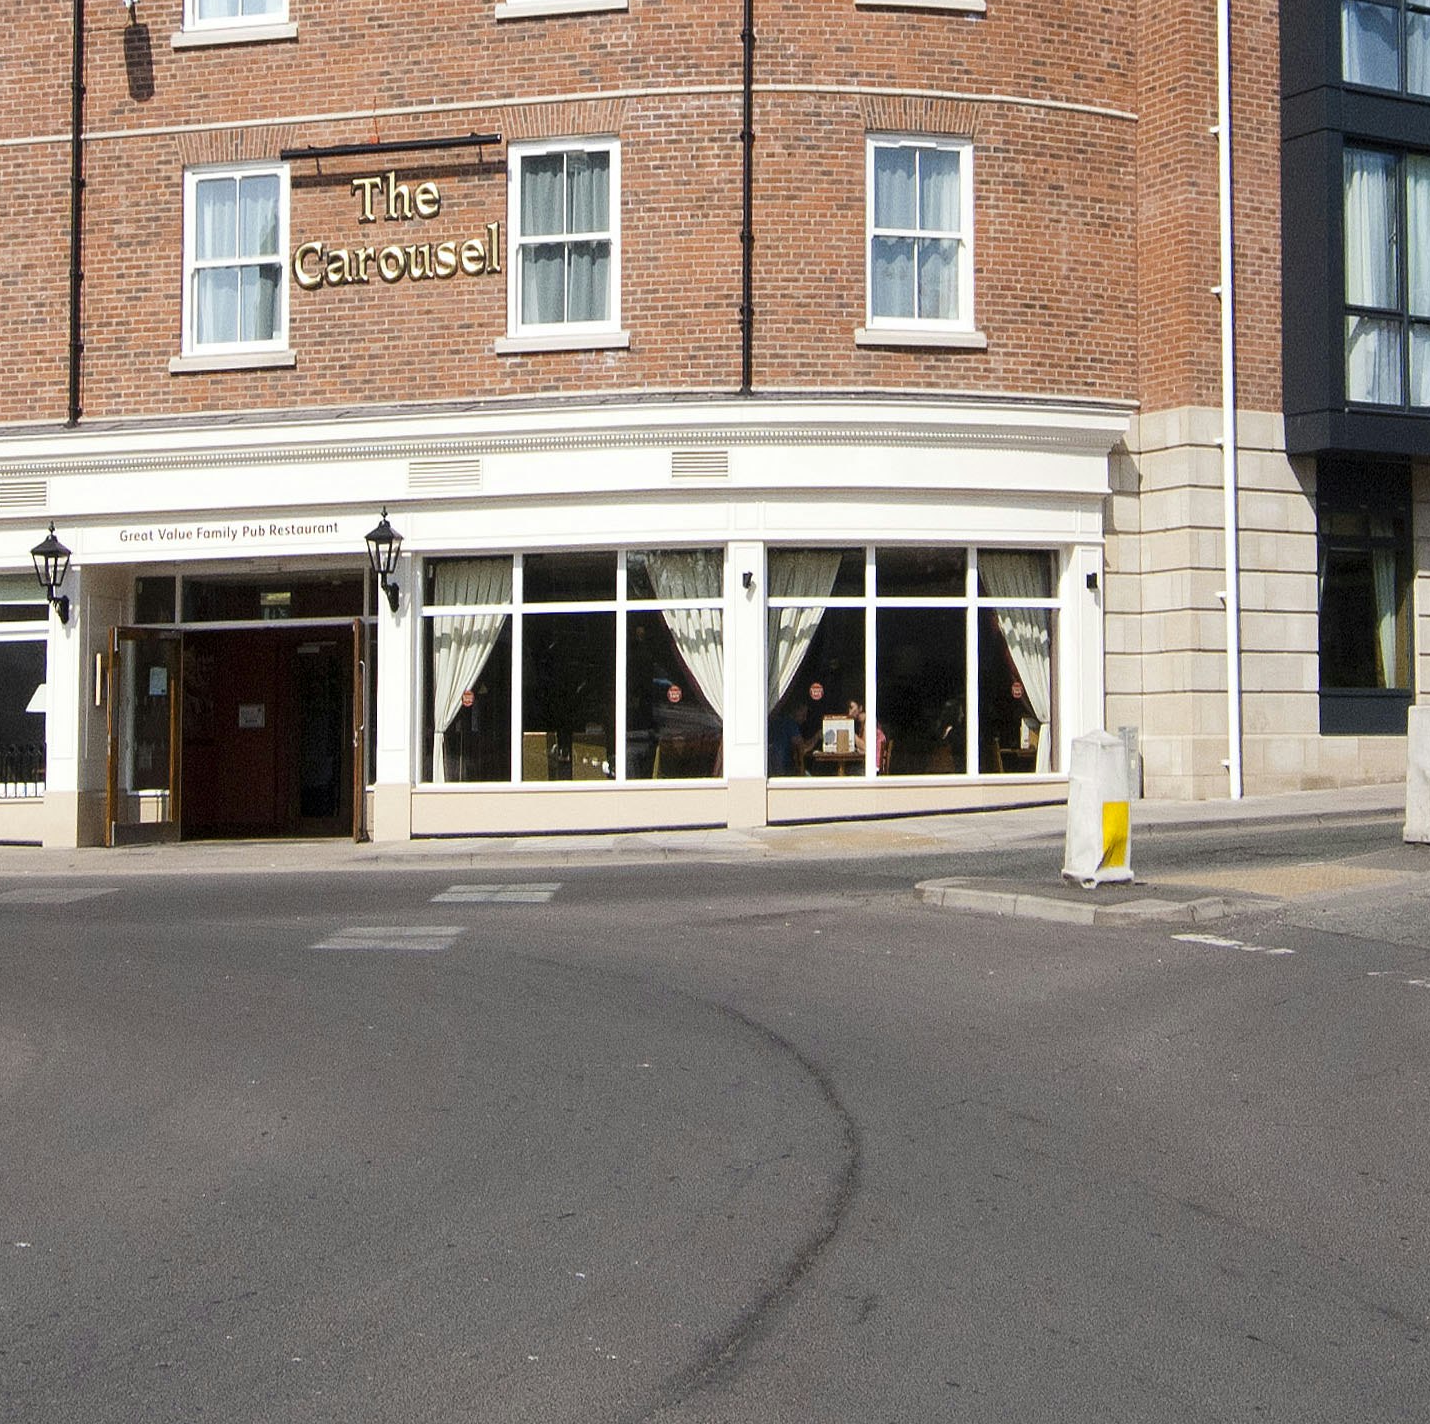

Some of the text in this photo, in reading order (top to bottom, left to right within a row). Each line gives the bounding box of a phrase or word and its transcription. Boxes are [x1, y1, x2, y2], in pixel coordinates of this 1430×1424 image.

[351, 170, 441, 224] The
[293, 221, 502, 291] Carousel
[119, 522, 338, 542] Great Value Family Pub Restaurant
